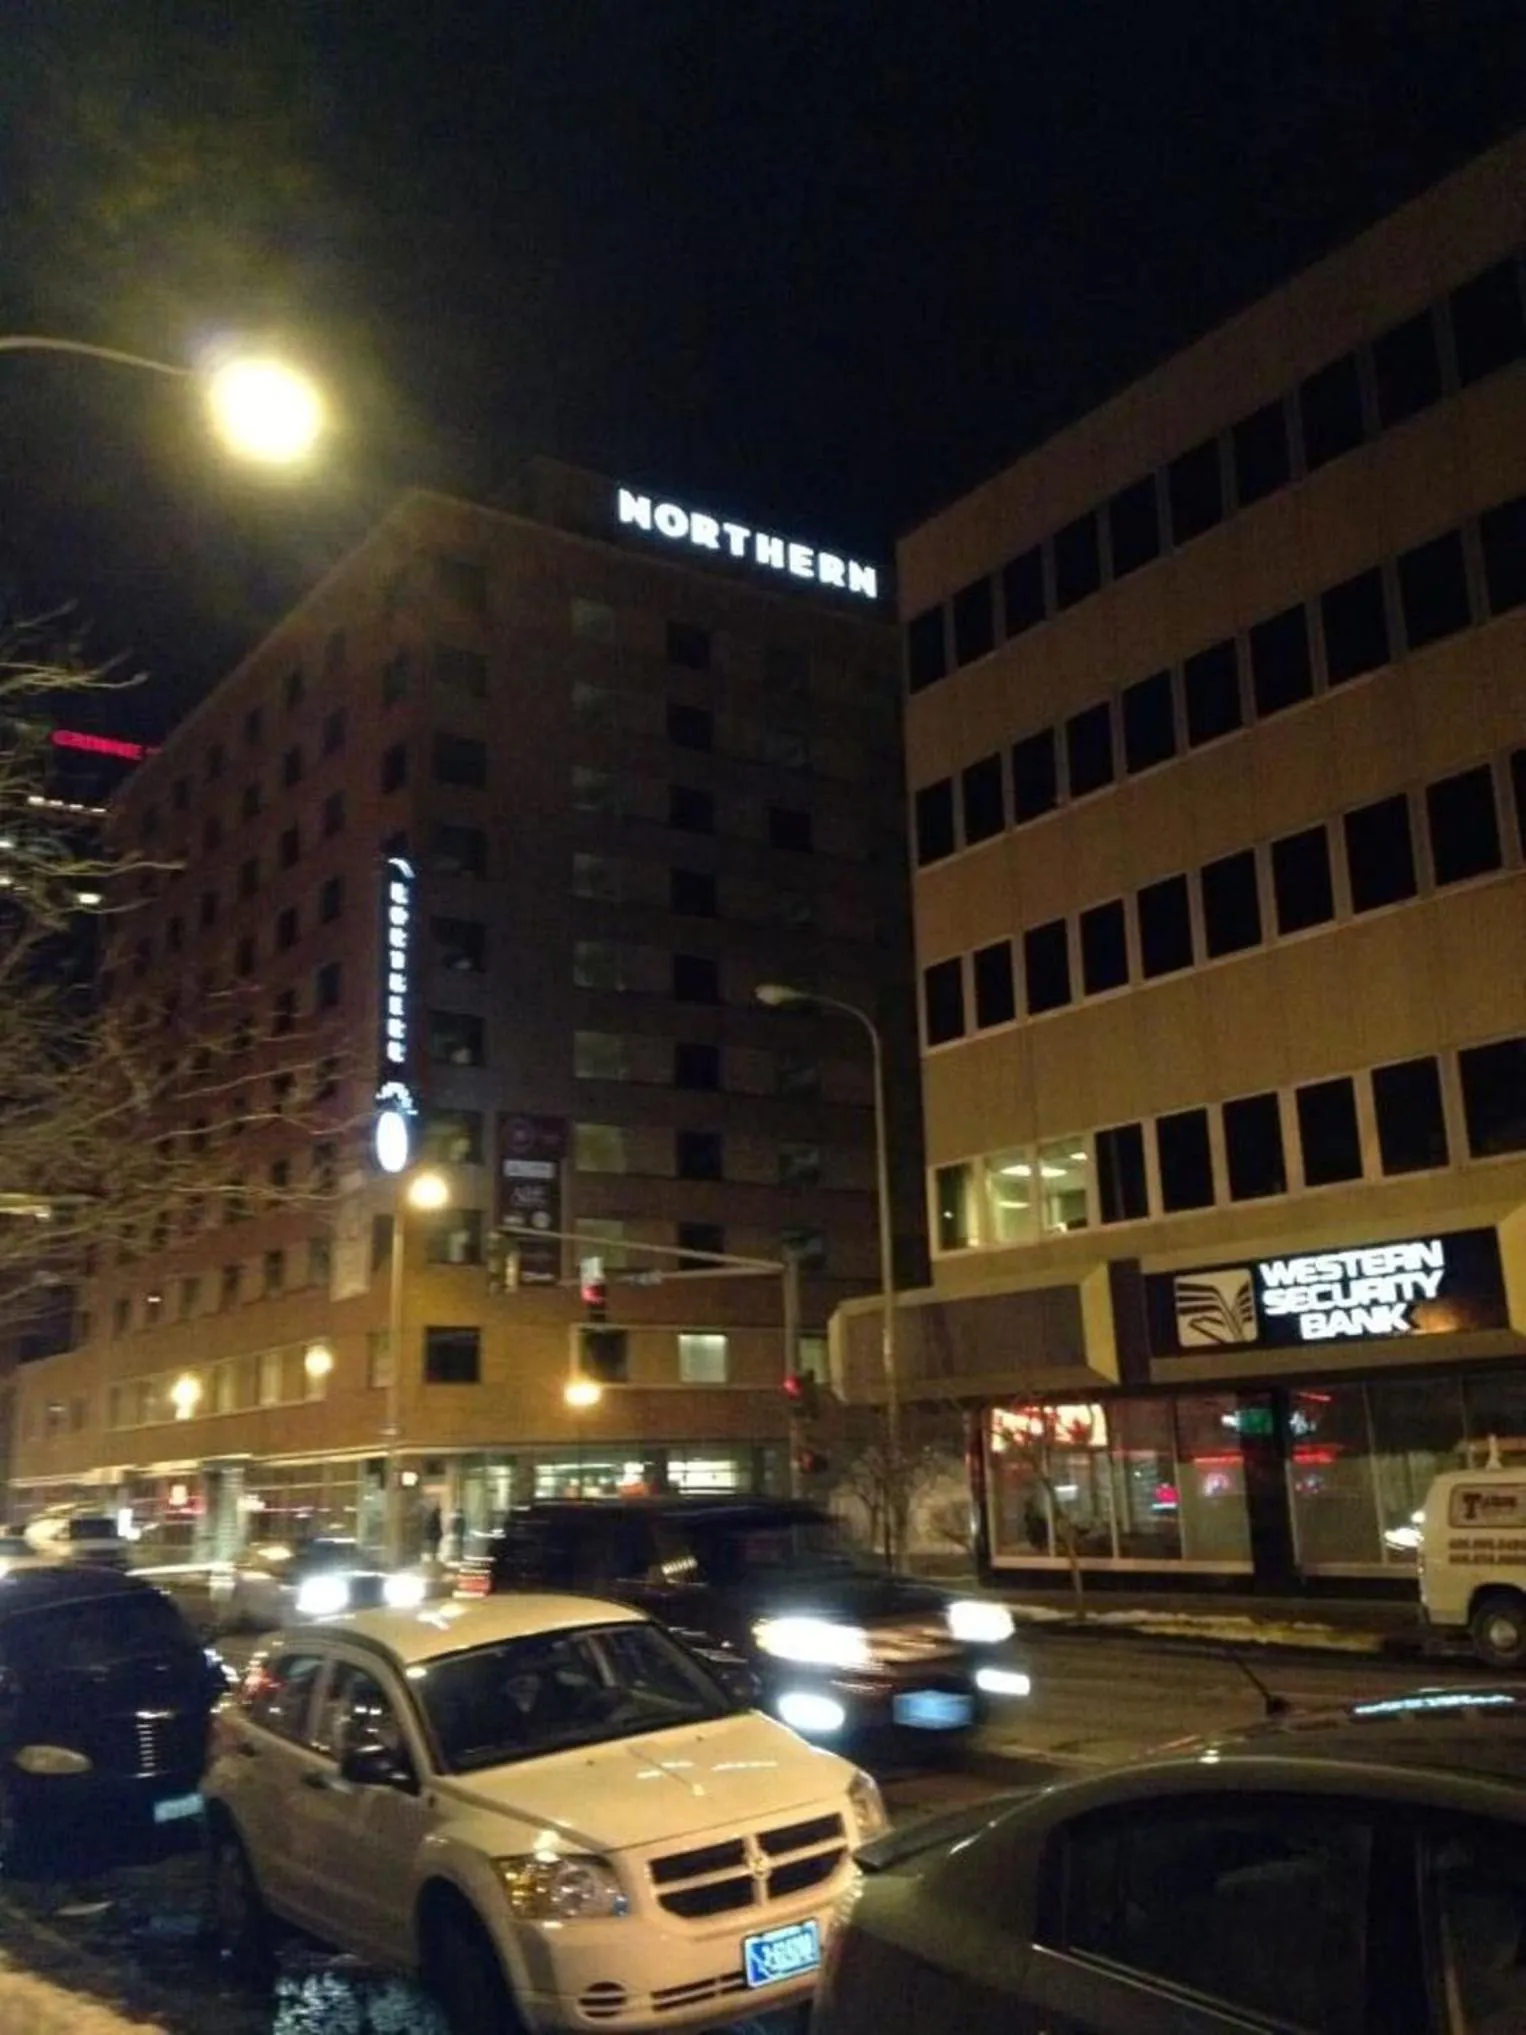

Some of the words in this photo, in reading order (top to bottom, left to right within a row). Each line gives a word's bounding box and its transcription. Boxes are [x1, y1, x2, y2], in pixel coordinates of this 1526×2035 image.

[618, 488, 878, 599] NORTHERN
[1259, 1240, 1444, 1287] WESTERN
[1262, 1269, 1444, 1315] SECURITY
[1299, 1303, 1411, 1340] BANK
